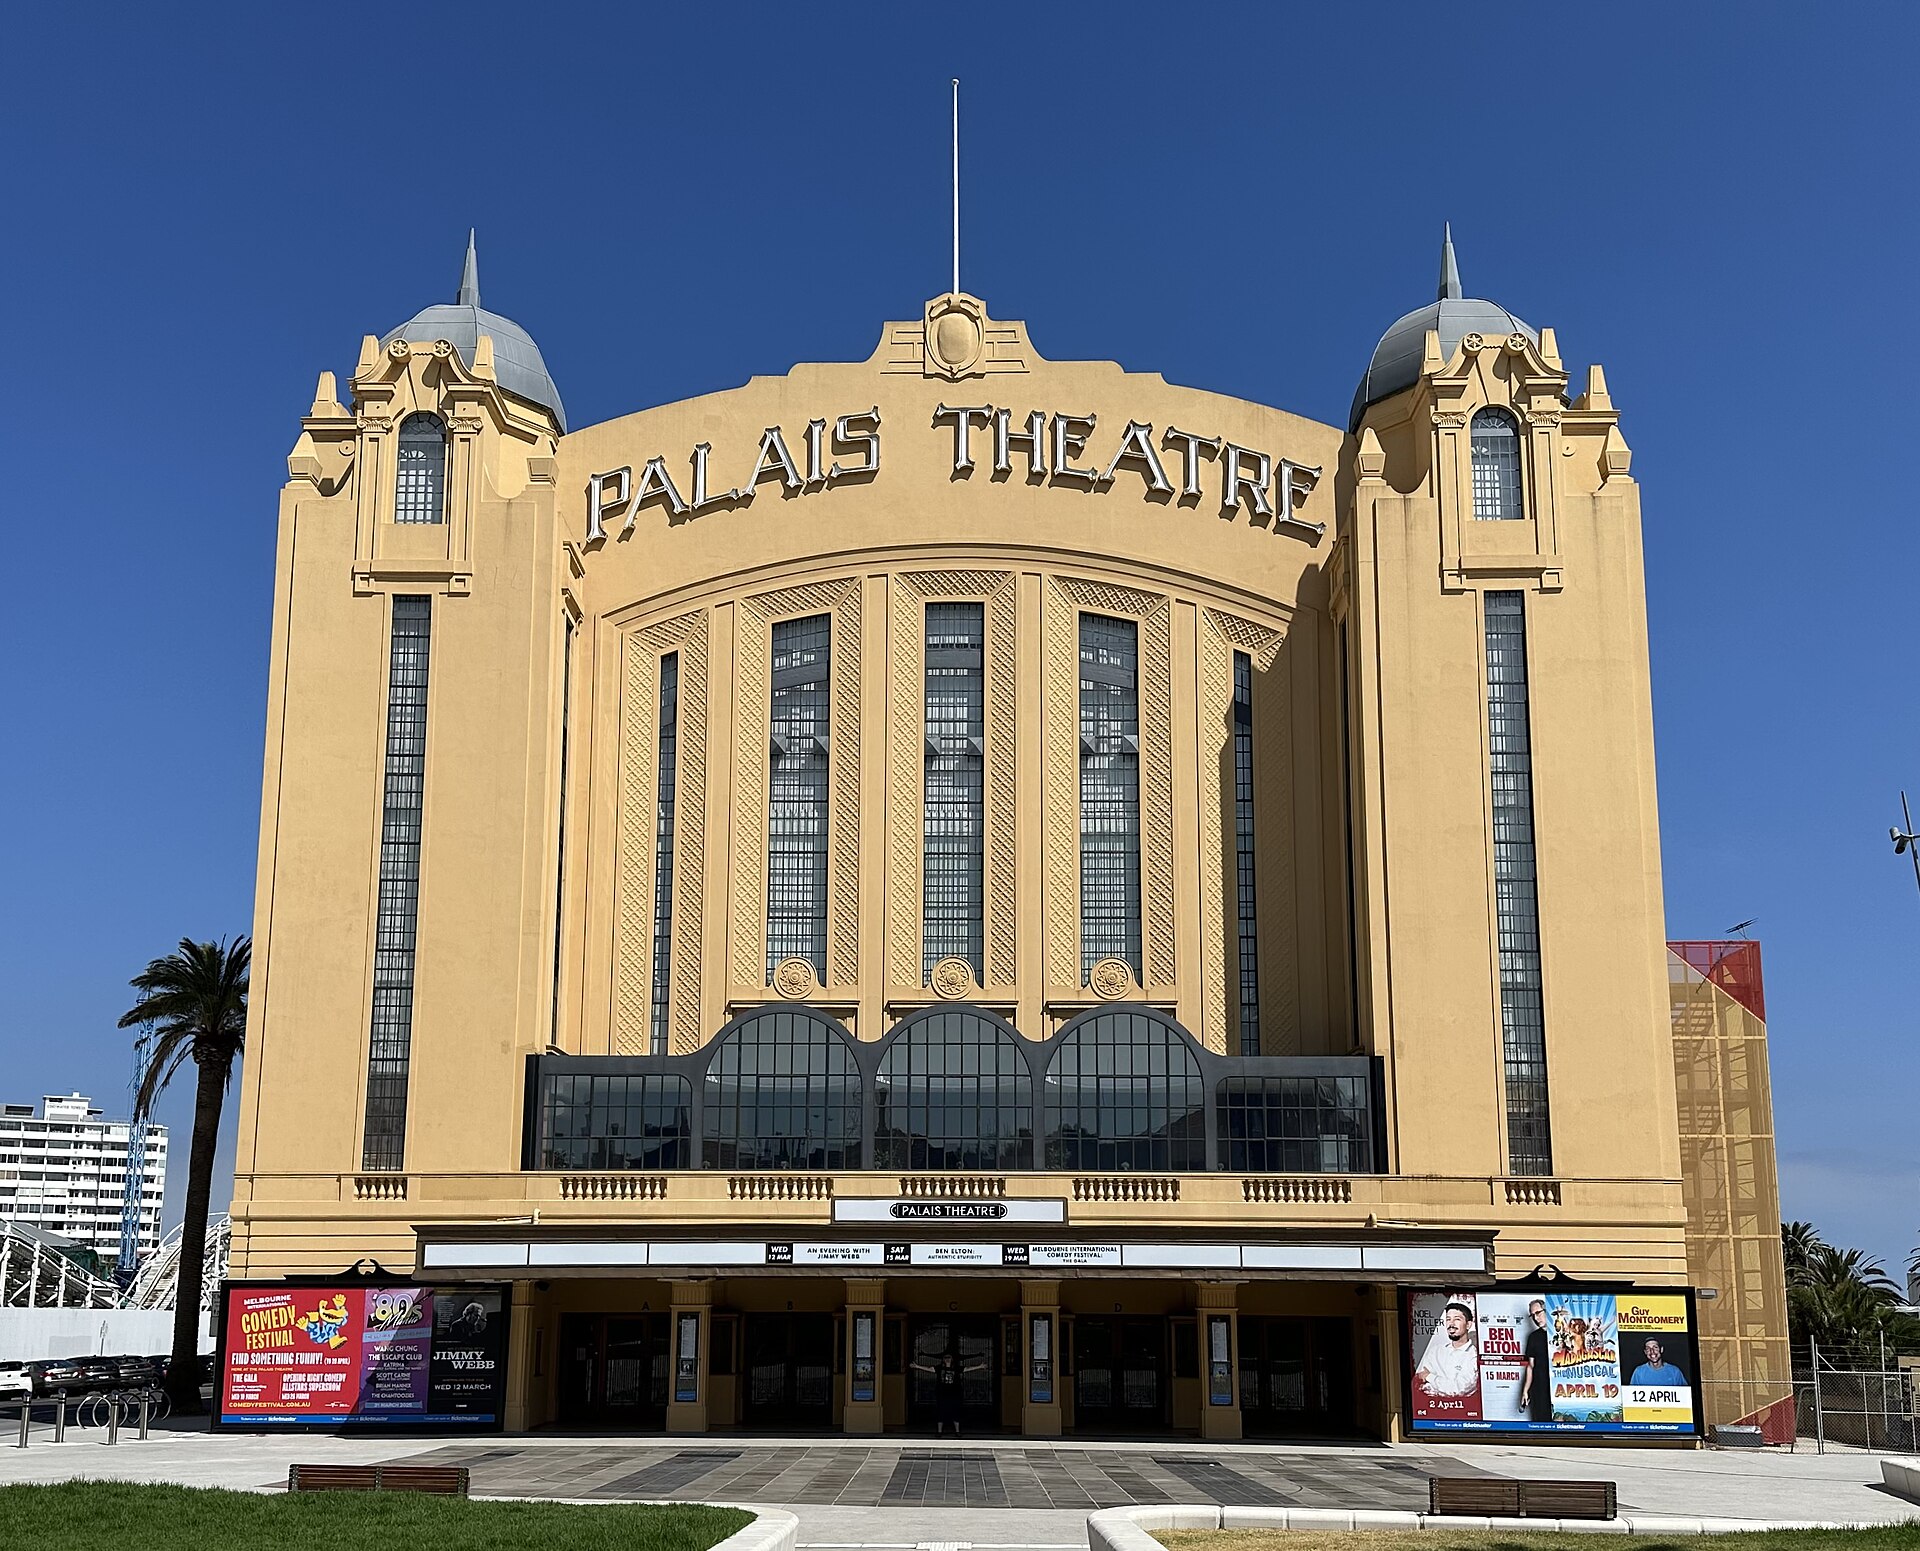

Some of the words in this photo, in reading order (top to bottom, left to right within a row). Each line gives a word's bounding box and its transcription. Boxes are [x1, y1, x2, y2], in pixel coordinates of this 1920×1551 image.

[586, 406, 881, 543] PALAIS
[934, 402, 1328, 536] THEATRE
[902, 1206, 941, 1216] PALAIS
[945, 1206, 995, 1216] THEATRE
[244, 1295, 291, 1305] MELBOURNE
[247, 1302, 288, 1310] INTERNATIONAL
[641, 1301, 650, 1311] A
[949, 1301, 958, 1311] C
[1114, 1302, 1122, 1312] D
[1414, 1310, 1434, 1318] NOEL
[241, 1305, 296, 1334] COMEDY
[1414, 1319, 1445, 1327] MILLER
[1415, 1327, 1439, 1335] LIVE!
[1489, 1328, 1514, 1340] BEN
[246, 1330, 295, 1350] FESTIVAL
[1484, 1341, 1520, 1354] ELTON
[231, 1352, 249, 1365] FIND
[250, 1352, 294, 1365] SOMETHING
[295, 1352, 323, 1365] FUNNY!
[433, 1351, 484, 1360] JIMMY
[1552, 1347, 1616, 1368] MADAGASCAR
[451, 1360, 495, 1370] WEBB
[1486, 1371, 1494, 1380] 15
[1496, 1371, 1520, 1380] MARCH
[1566, 1364, 1617, 1379] MUSICAL
[233, 1373, 243, 1382] THE
[244, 1373, 257, 1382] GALA
[283, 1373, 306, 1382] OPENING
[307, 1373, 323, 1382] NIGHT
[324, 1373, 346, 1382] COMEDY
[282, 1382, 308, 1391] ALLSTARS
[309, 1382, 341, 1391] SUPERSHOW
[1555, 1383, 1599, 1397] APRIL
[1602, 1384, 1619, 1398] 19
[1632, 1391, 1646, 1402] 12
[1649, 1391, 1681, 1403] APRIL
[1437, 1400, 1464, 1409] April
